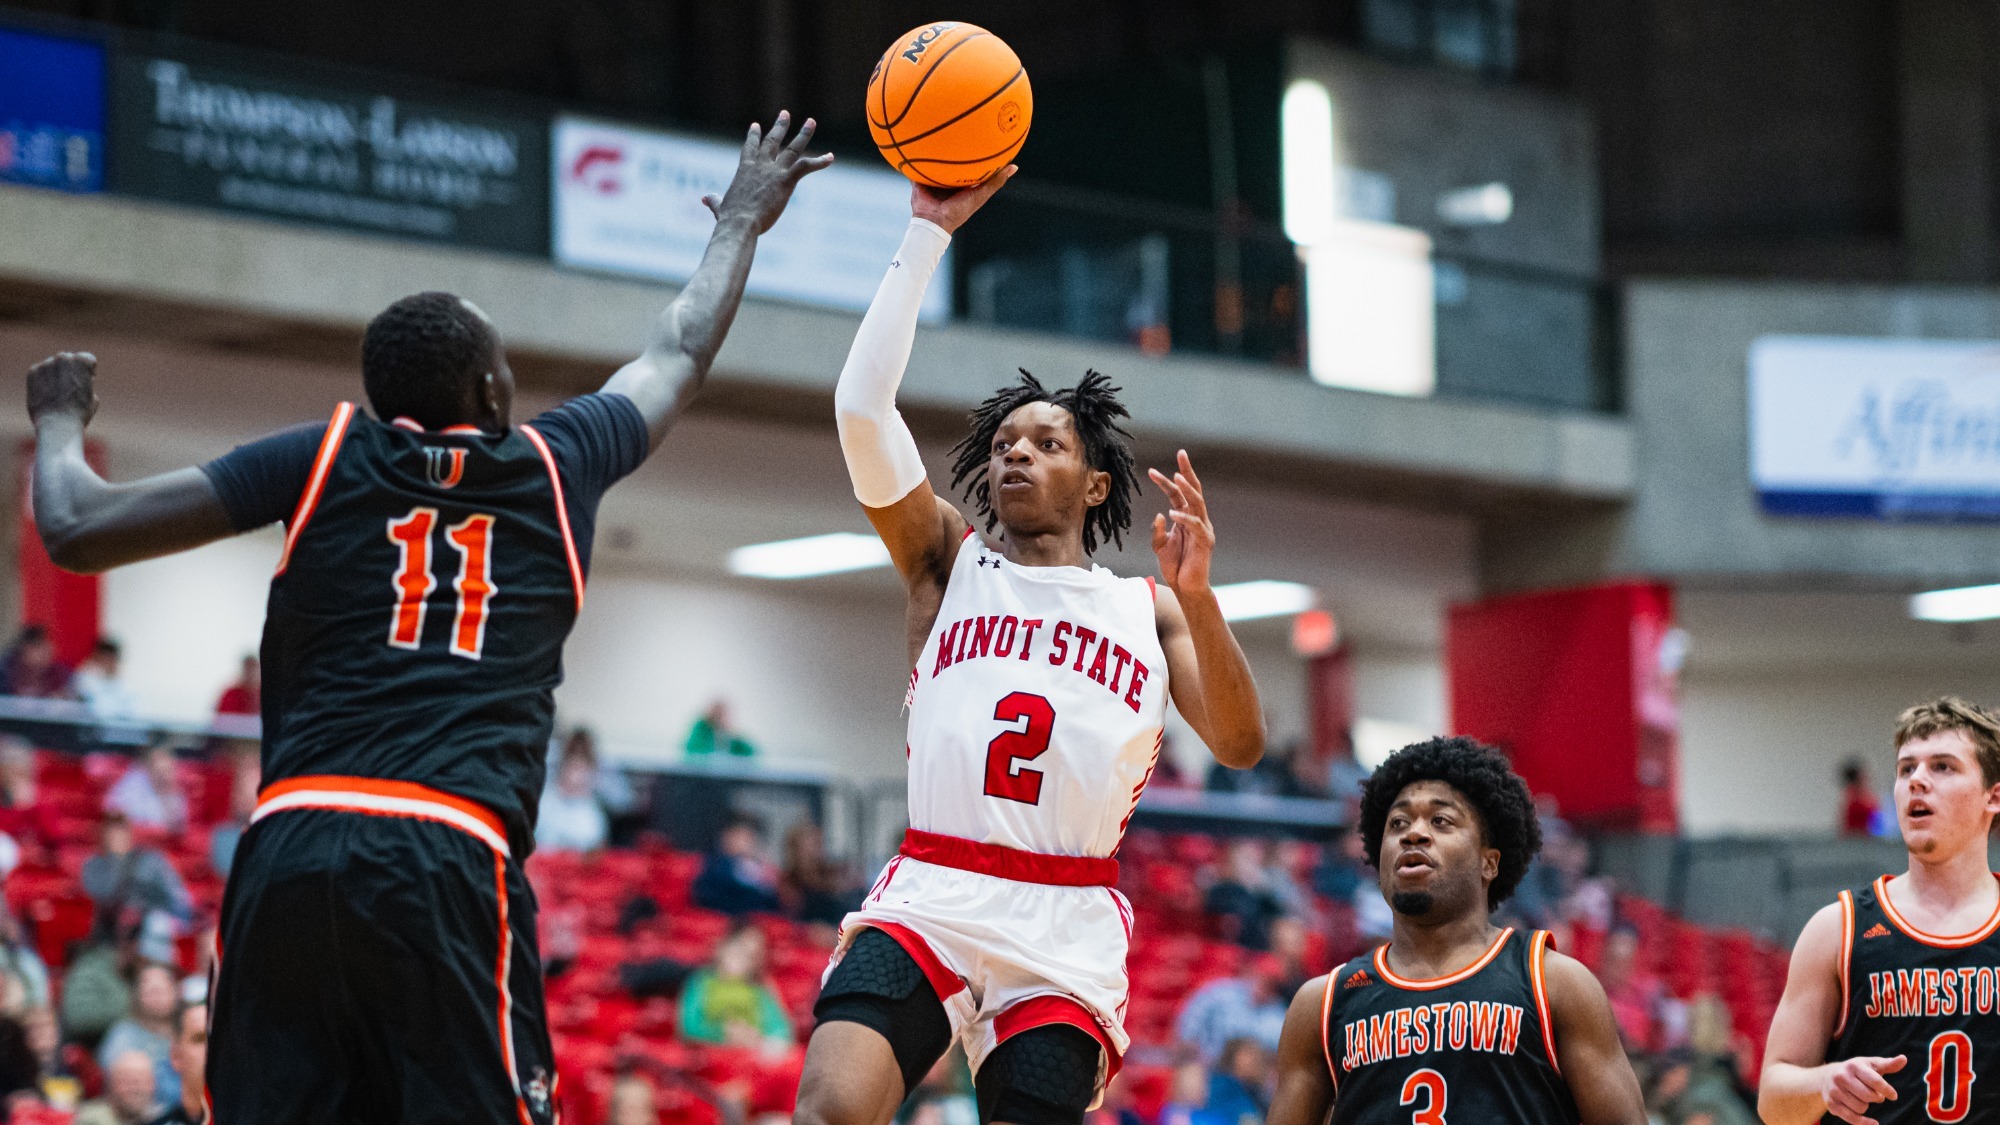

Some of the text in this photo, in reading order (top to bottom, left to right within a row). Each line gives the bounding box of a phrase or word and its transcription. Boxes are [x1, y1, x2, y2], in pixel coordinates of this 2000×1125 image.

[422, 446, 470, 489] U
[387, 506, 499, 660] 11
[932, 614, 1149, 714] MINOT STATE
[983, 691, 1056, 806] 2
[1865, 966, 2000, 1017] JAMESTO
[1342, 1000, 1524, 1073] JAMESTOWN
[1923, 1030, 1977, 1125] 0
[1400, 1067, 1448, 1125] 3
